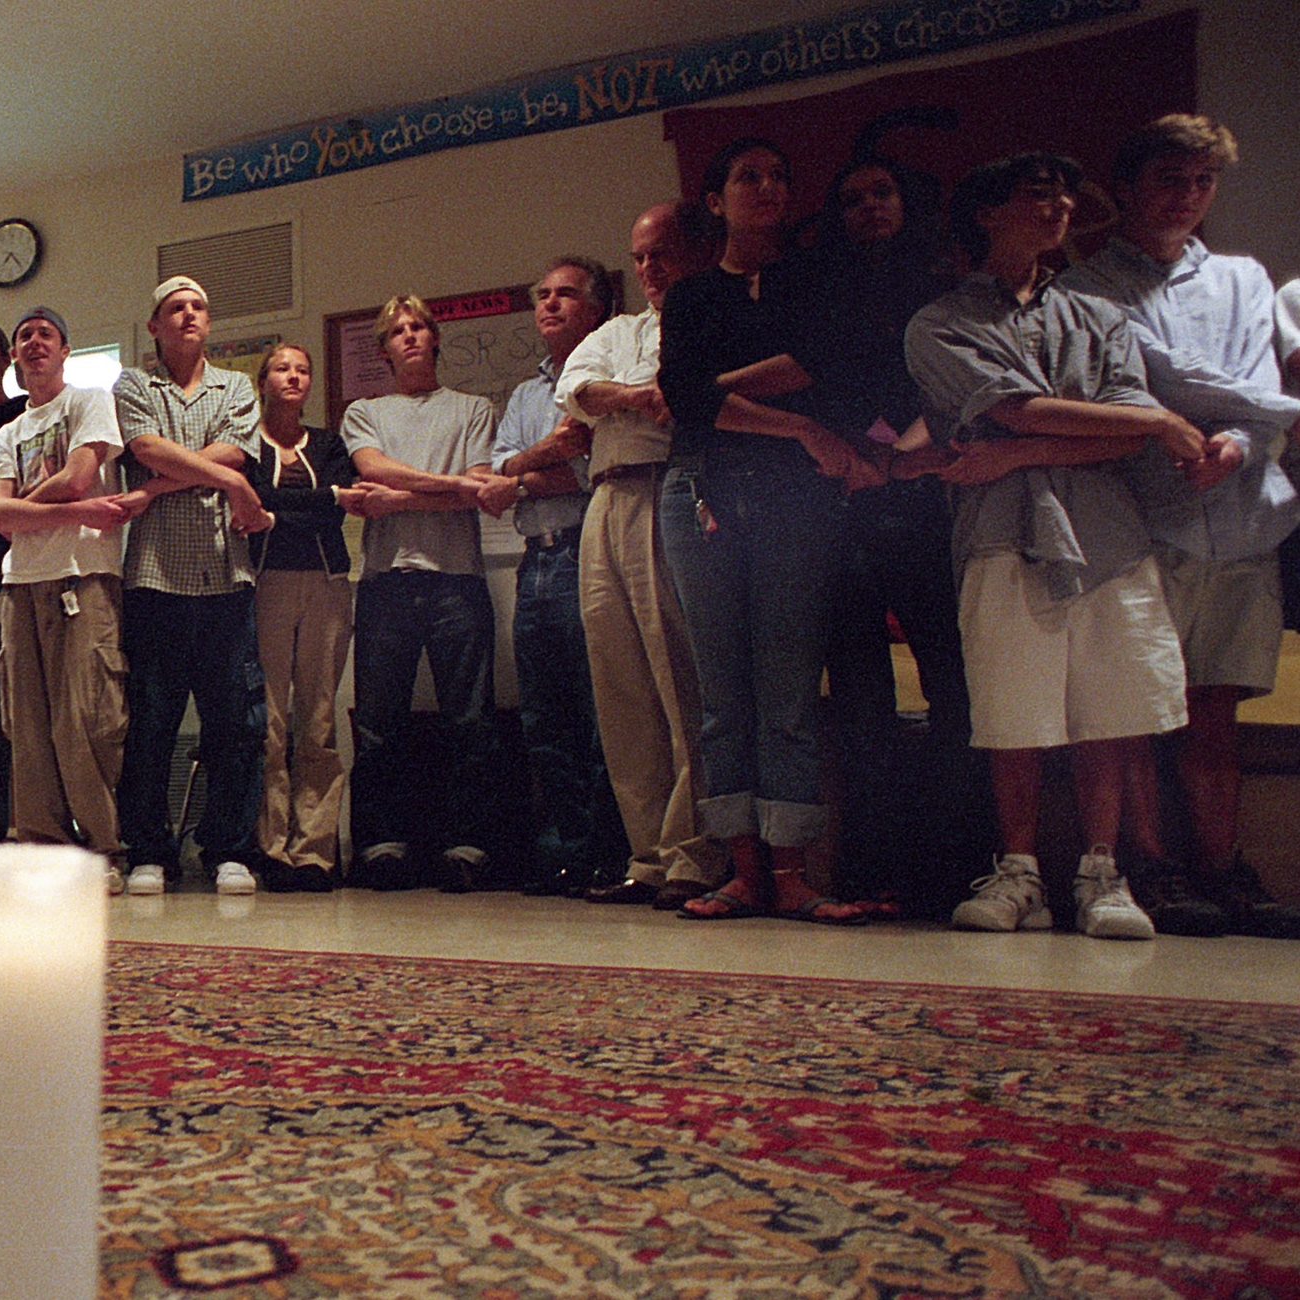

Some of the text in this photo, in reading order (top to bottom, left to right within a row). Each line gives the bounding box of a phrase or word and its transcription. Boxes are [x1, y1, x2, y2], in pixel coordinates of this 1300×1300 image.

[189, 155, 235, 197] Be
[241, 140, 309, 183] who
[310, 126, 376, 176] You
[379, 104, 493, 155] choose
[500, 107, 518, 122] to
[520, 88, 568, 127] be,
[573, 56, 675, 121] NOT
[678, 50, 752, 93] who
[760, 19, 881, 76] others
[894, 0, 1019, 49] choose
